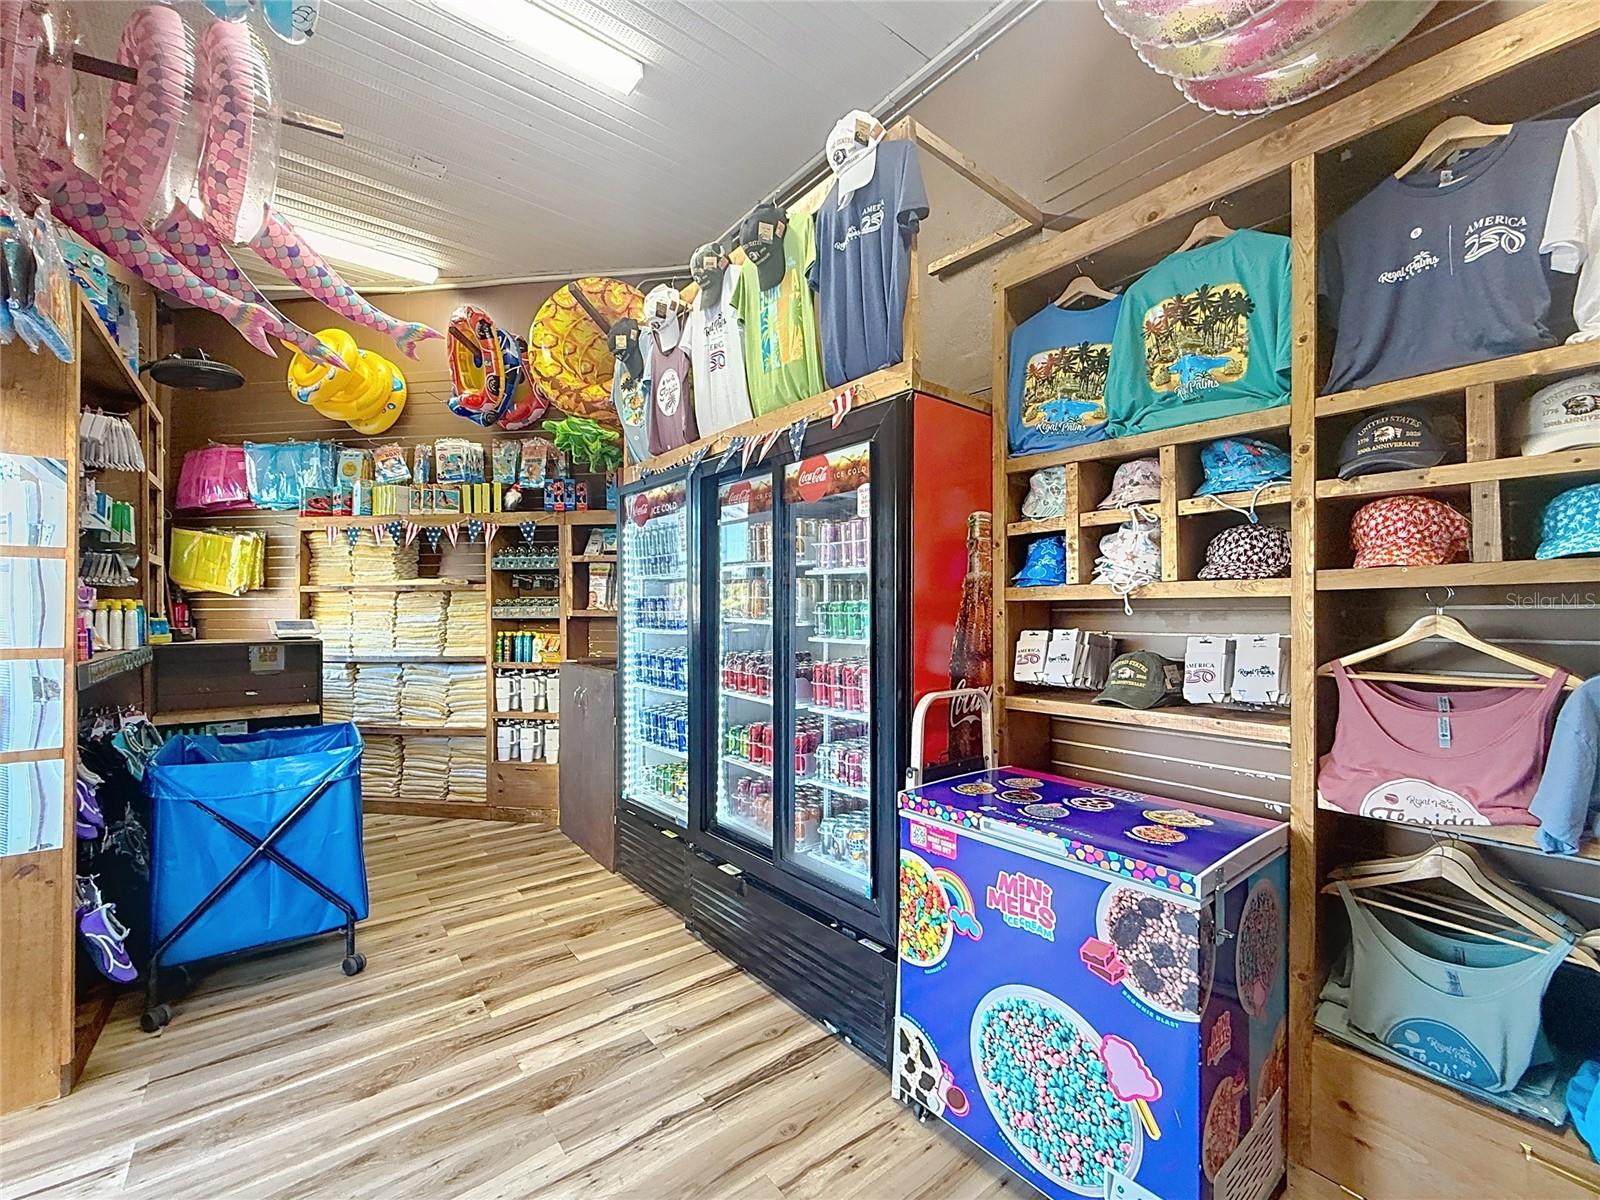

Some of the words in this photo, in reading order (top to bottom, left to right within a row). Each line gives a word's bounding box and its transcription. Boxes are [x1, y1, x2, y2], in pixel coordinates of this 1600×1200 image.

[1465, 214, 1528, 235] AMERICA
[1464, 225, 1526, 263] 250
[1378, 268, 1406, 284] Regal
[1405, 256, 1440, 273] Palms
[1187, 379, 1220, 393] Palms
[1034, 421, 1059, 433] Regal
[1060, 421, 1087, 432] Palms
[1358, 416, 1389, 437] UNITED
[1389, 415, 1422, 428] STATES
[1371, 441, 1422, 452] ANNIVERSARY
[833, 472, 845, 480] ICE
[847, 465, 867, 476] COLD
[661, 501, 678, 513] COLD
[1016, 653, 1041, 665] 250
[1185, 669, 1216, 684] 250
[986, 886, 1056, 930] MELTS
[1003, 912, 1019, 927] ICE
[1018, 916, 1055, 941] CREAM
[1121, 989, 1155, 1018] BROWNIE
[1155, 1014, 1180, 1029] BLAST
